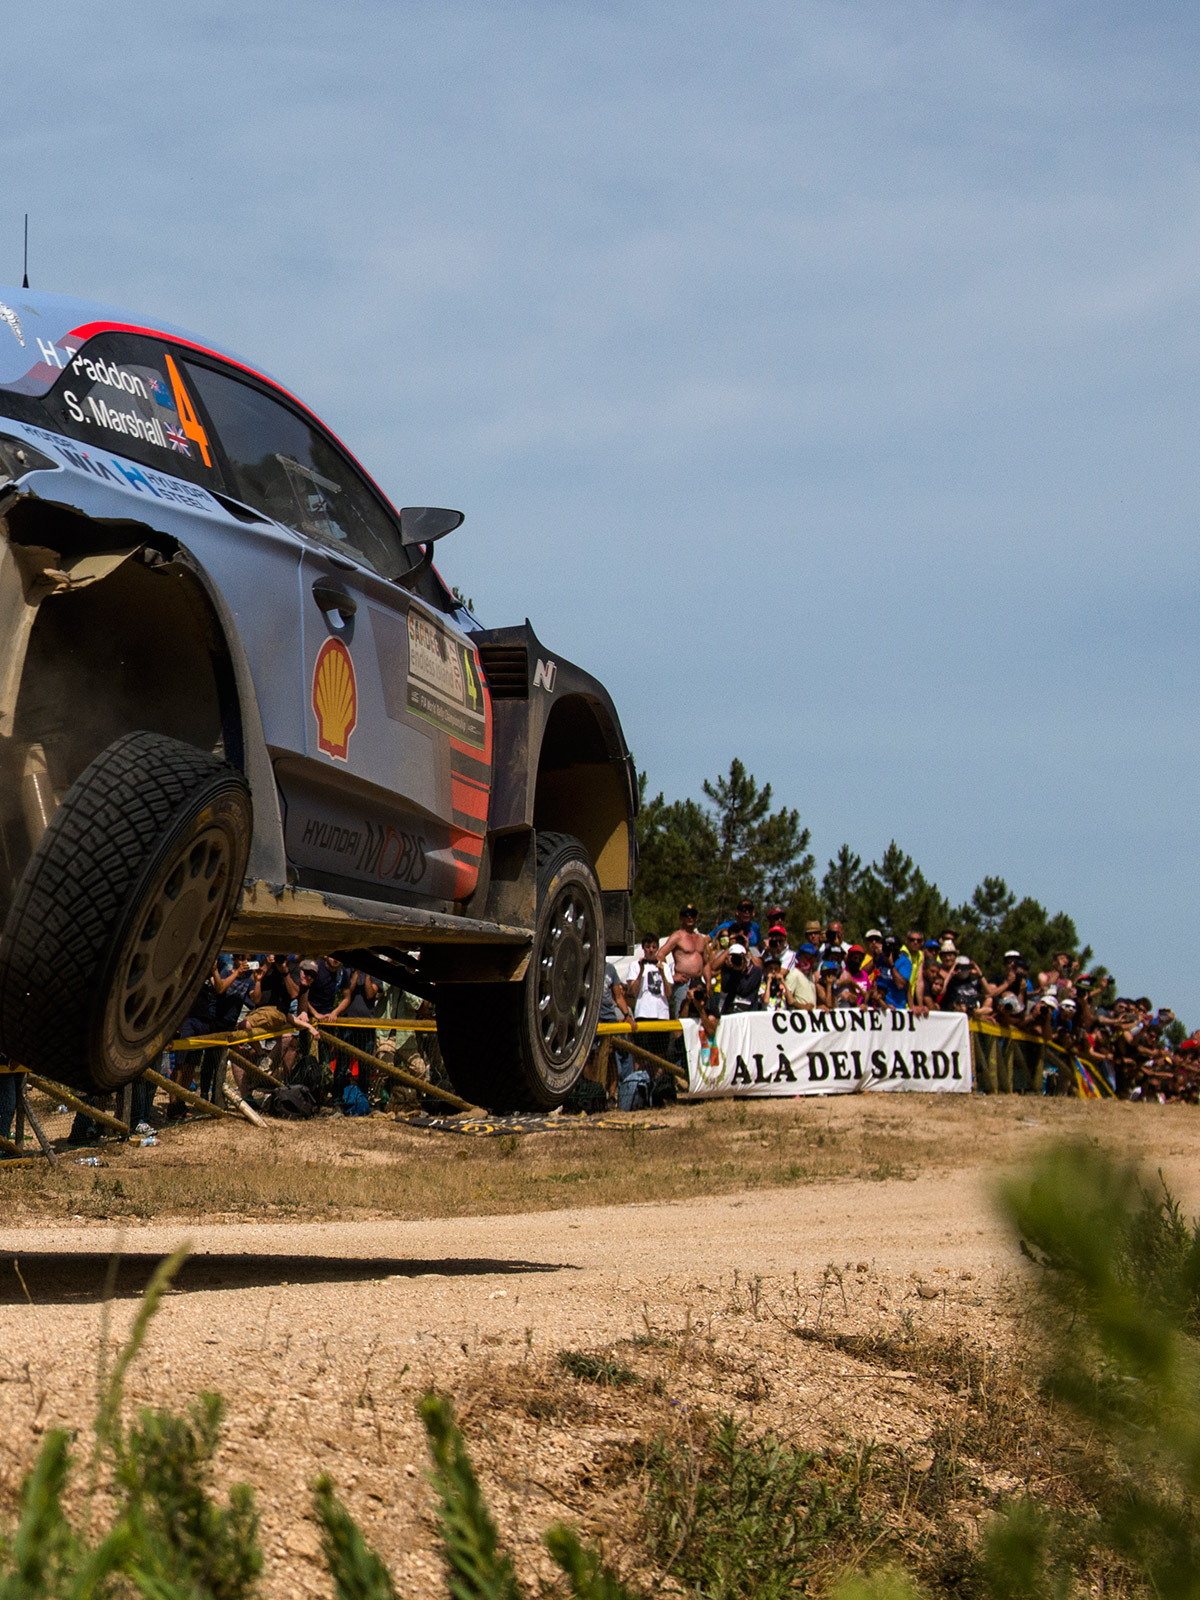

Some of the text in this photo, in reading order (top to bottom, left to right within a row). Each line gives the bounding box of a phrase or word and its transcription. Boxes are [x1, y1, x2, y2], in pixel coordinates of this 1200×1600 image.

[36, 337, 149, 399] H. Paddon
[63, 390, 167, 448] S. Marshall
[164, 353, 213, 469] 4
[20, 423, 79, 452] HYUNDAI
[142, 471, 214, 503] HYUNDAI
[156, 488, 213, 513] STEEL
[408, 615, 450, 663] SARDEG
[464, 648, 478, 711] 4
[301, 818, 362, 857] HYUNDAI
[355, 819, 427, 885] MOBIS
[771, 1010, 916, 1034] COMUNE DI
[730, 1044, 963, 1086] ALÀ DEI SARDI
